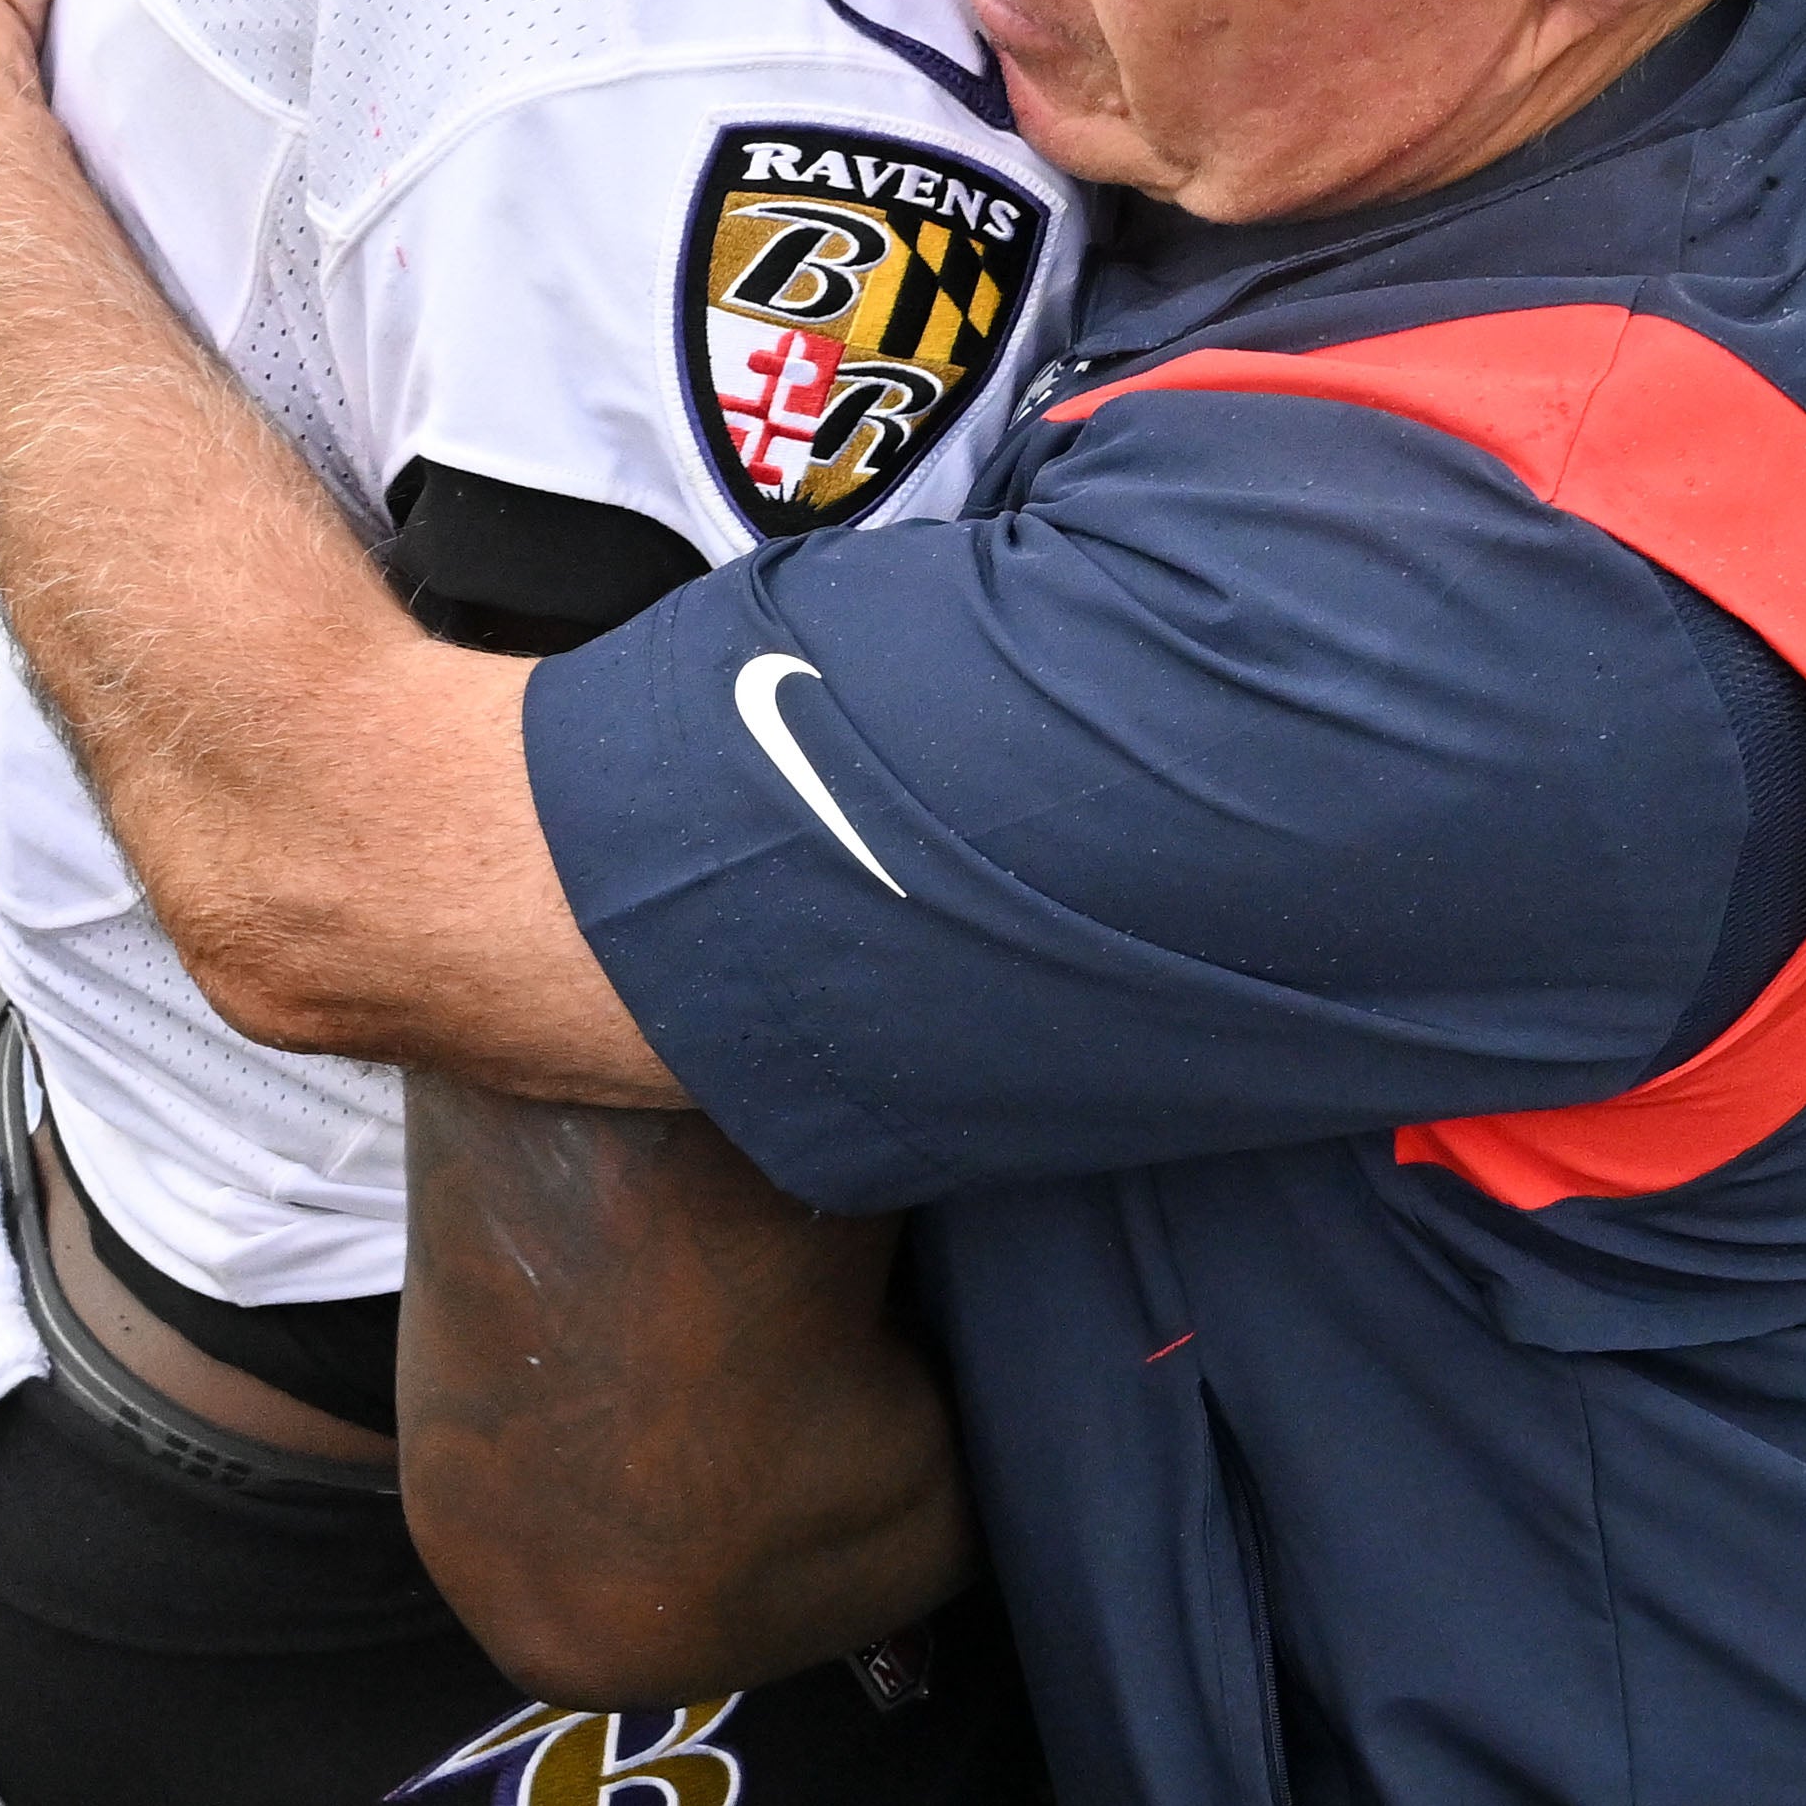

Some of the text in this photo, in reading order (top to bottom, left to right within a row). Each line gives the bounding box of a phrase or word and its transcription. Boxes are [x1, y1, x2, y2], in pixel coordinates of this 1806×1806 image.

[742, 142, 1021, 242] RAVENS
[725, 201, 892, 325] B
[809, 360, 944, 475] R
